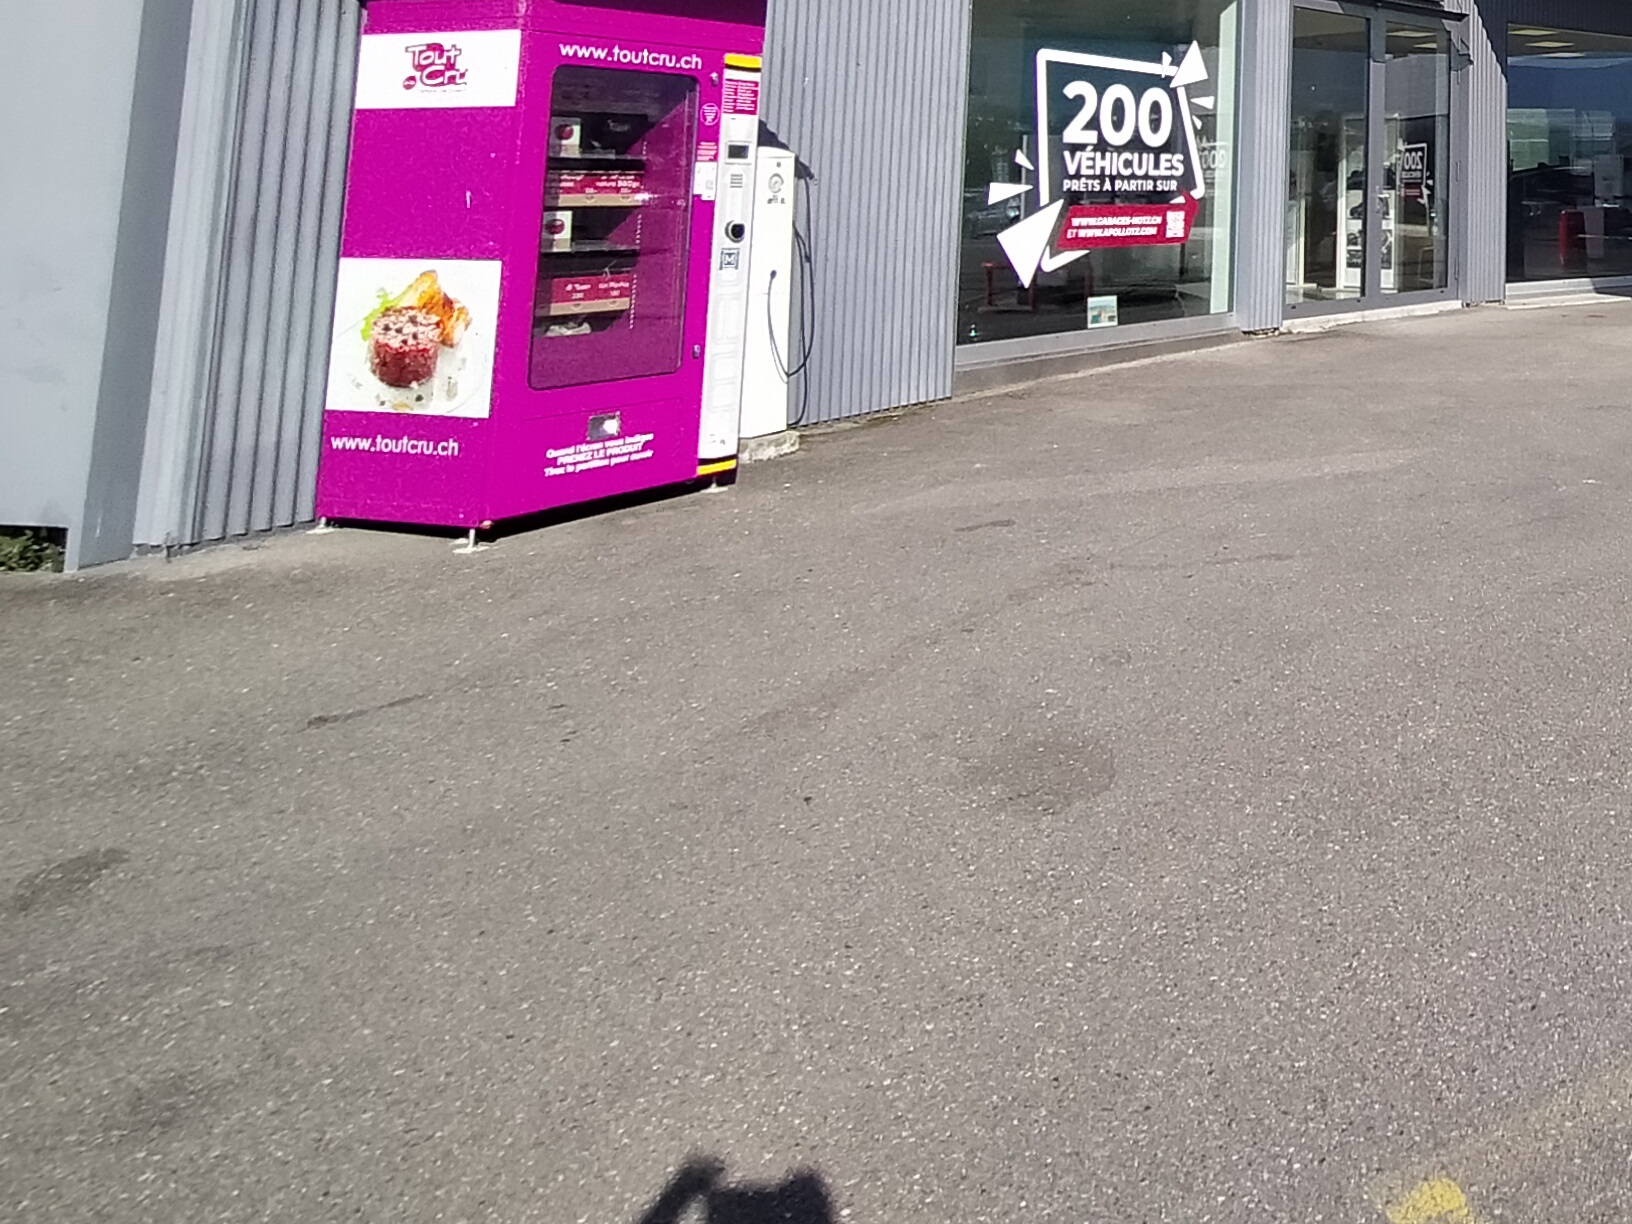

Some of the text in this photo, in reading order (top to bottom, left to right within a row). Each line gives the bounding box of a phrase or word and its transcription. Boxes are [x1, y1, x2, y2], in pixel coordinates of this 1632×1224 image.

[559, 43, 702, 70] www.toutcru.ch
[1062, 80, 1173, 148] 200
[1062, 145, 1185, 177] VÉHICULES
[1063, 176, 1178, 192] PRÊTS À PARTIR SUR
[330, 434, 459, 456] www.toutcru.ch
[594, 448, 606, 459] LE
